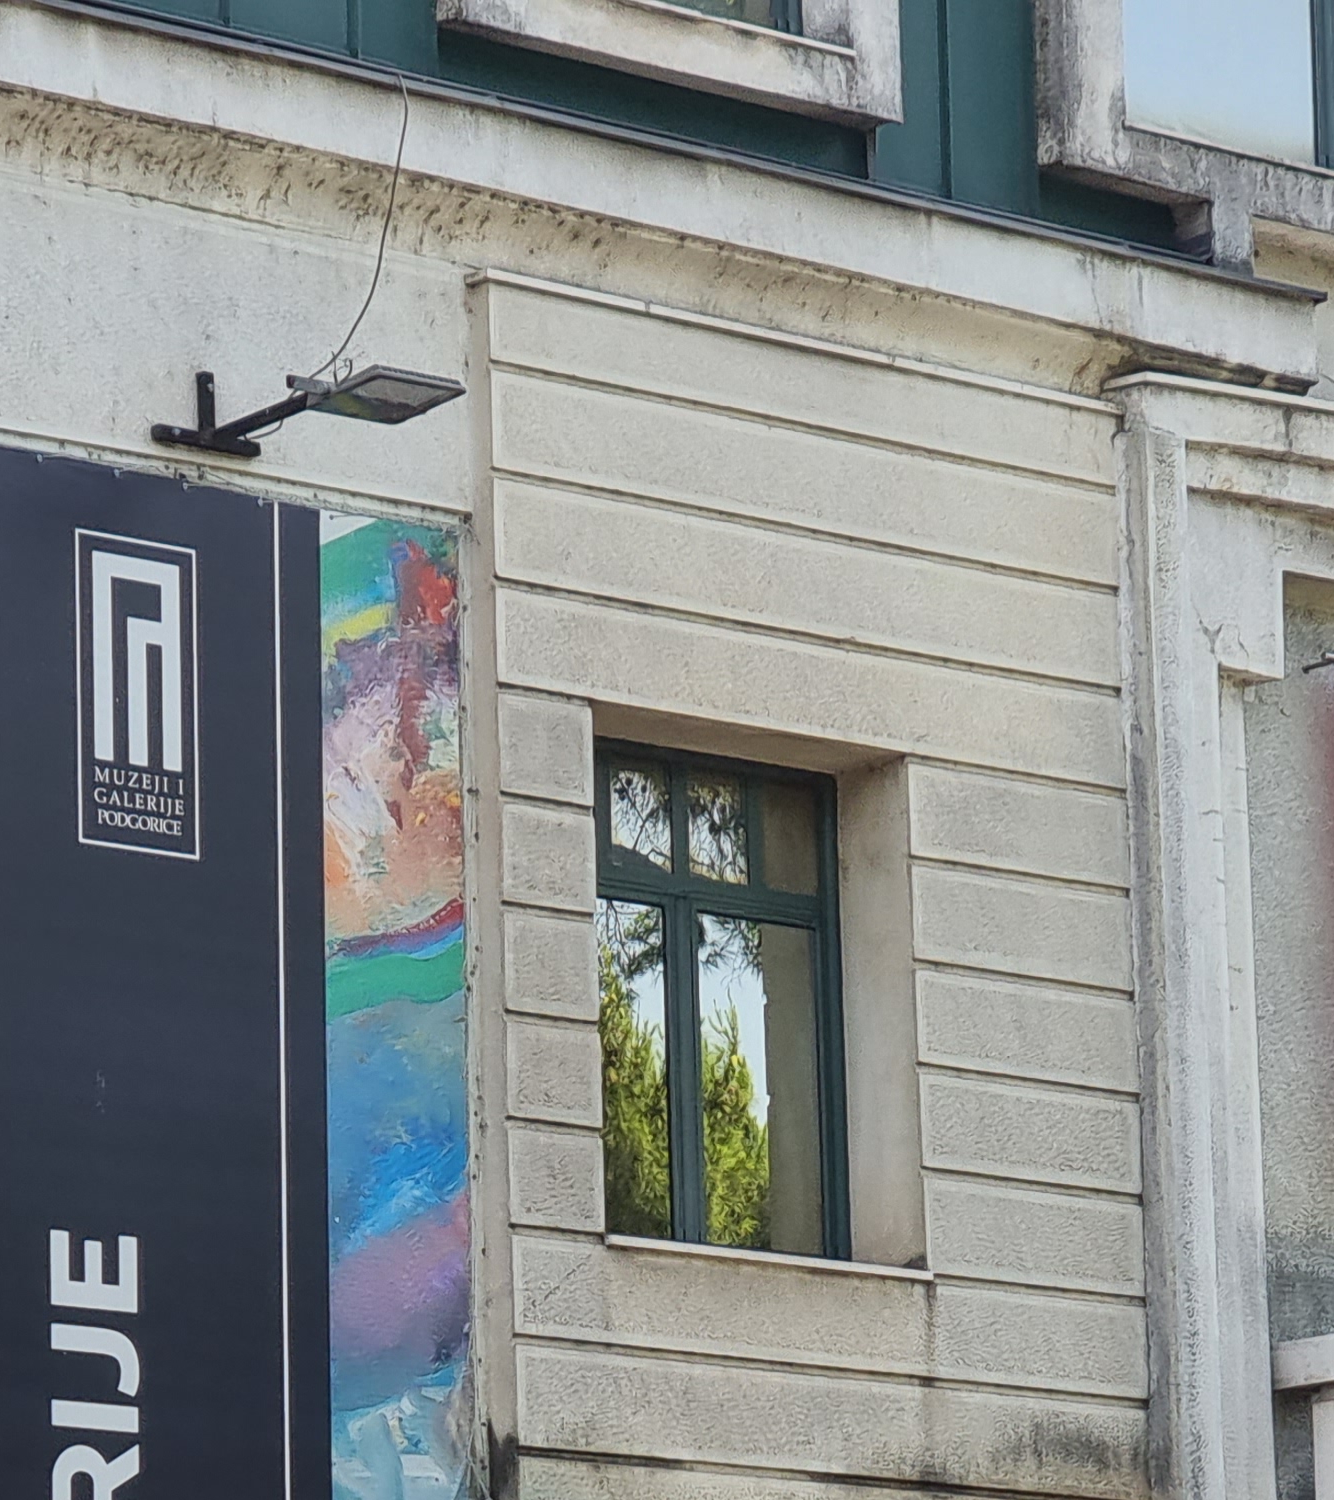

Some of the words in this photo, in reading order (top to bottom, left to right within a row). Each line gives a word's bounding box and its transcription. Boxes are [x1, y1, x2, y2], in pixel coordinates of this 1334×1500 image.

[94, 765, 169, 794] MUZEJI
[178, 778, 184, 796] I
[93, 787, 185, 817] GALERIJE
[97, 808, 182, 836] PODGORICE
